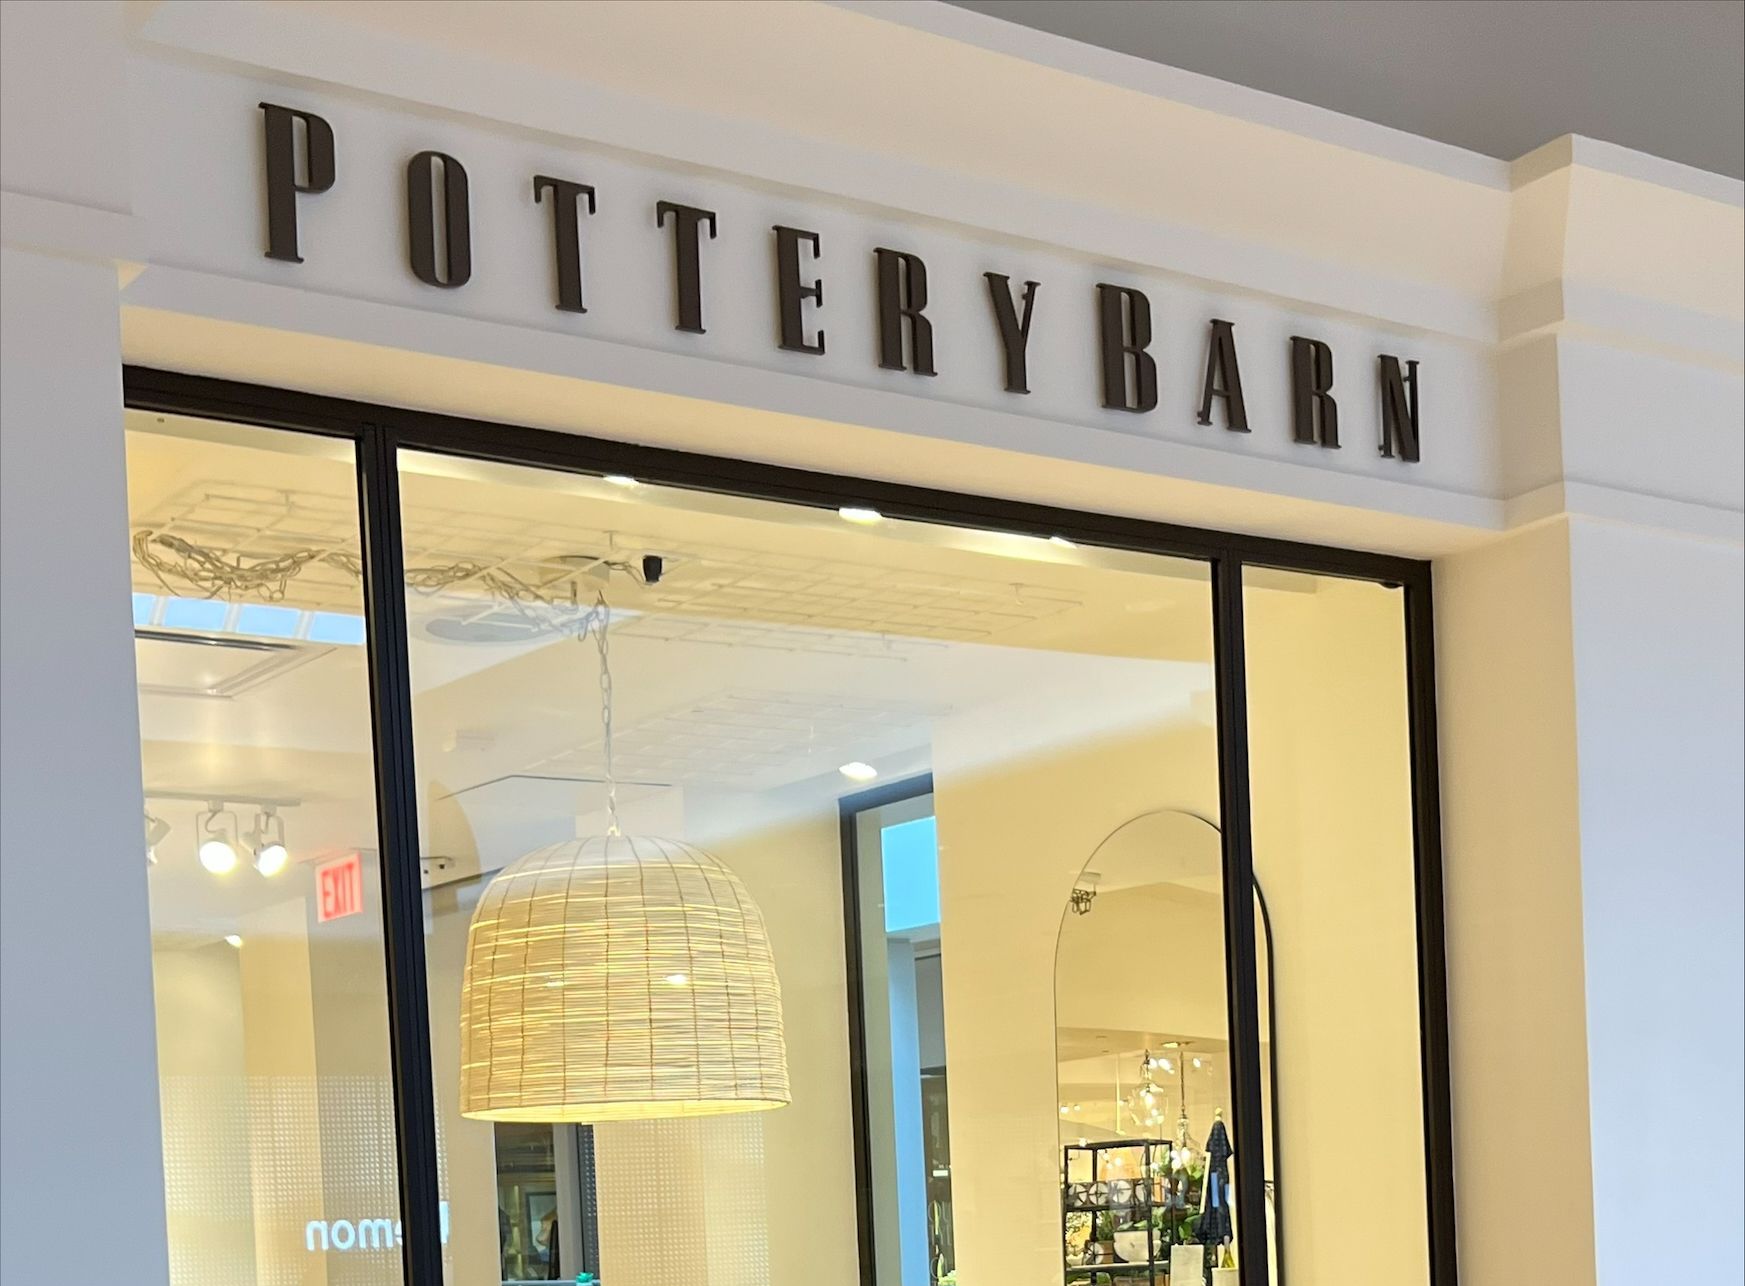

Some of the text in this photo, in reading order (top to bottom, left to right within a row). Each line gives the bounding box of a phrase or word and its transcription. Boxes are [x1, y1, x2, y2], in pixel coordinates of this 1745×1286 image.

[259, 102, 1420, 463] POTTERY BARN
[321, 863, 355, 919] EXIT
